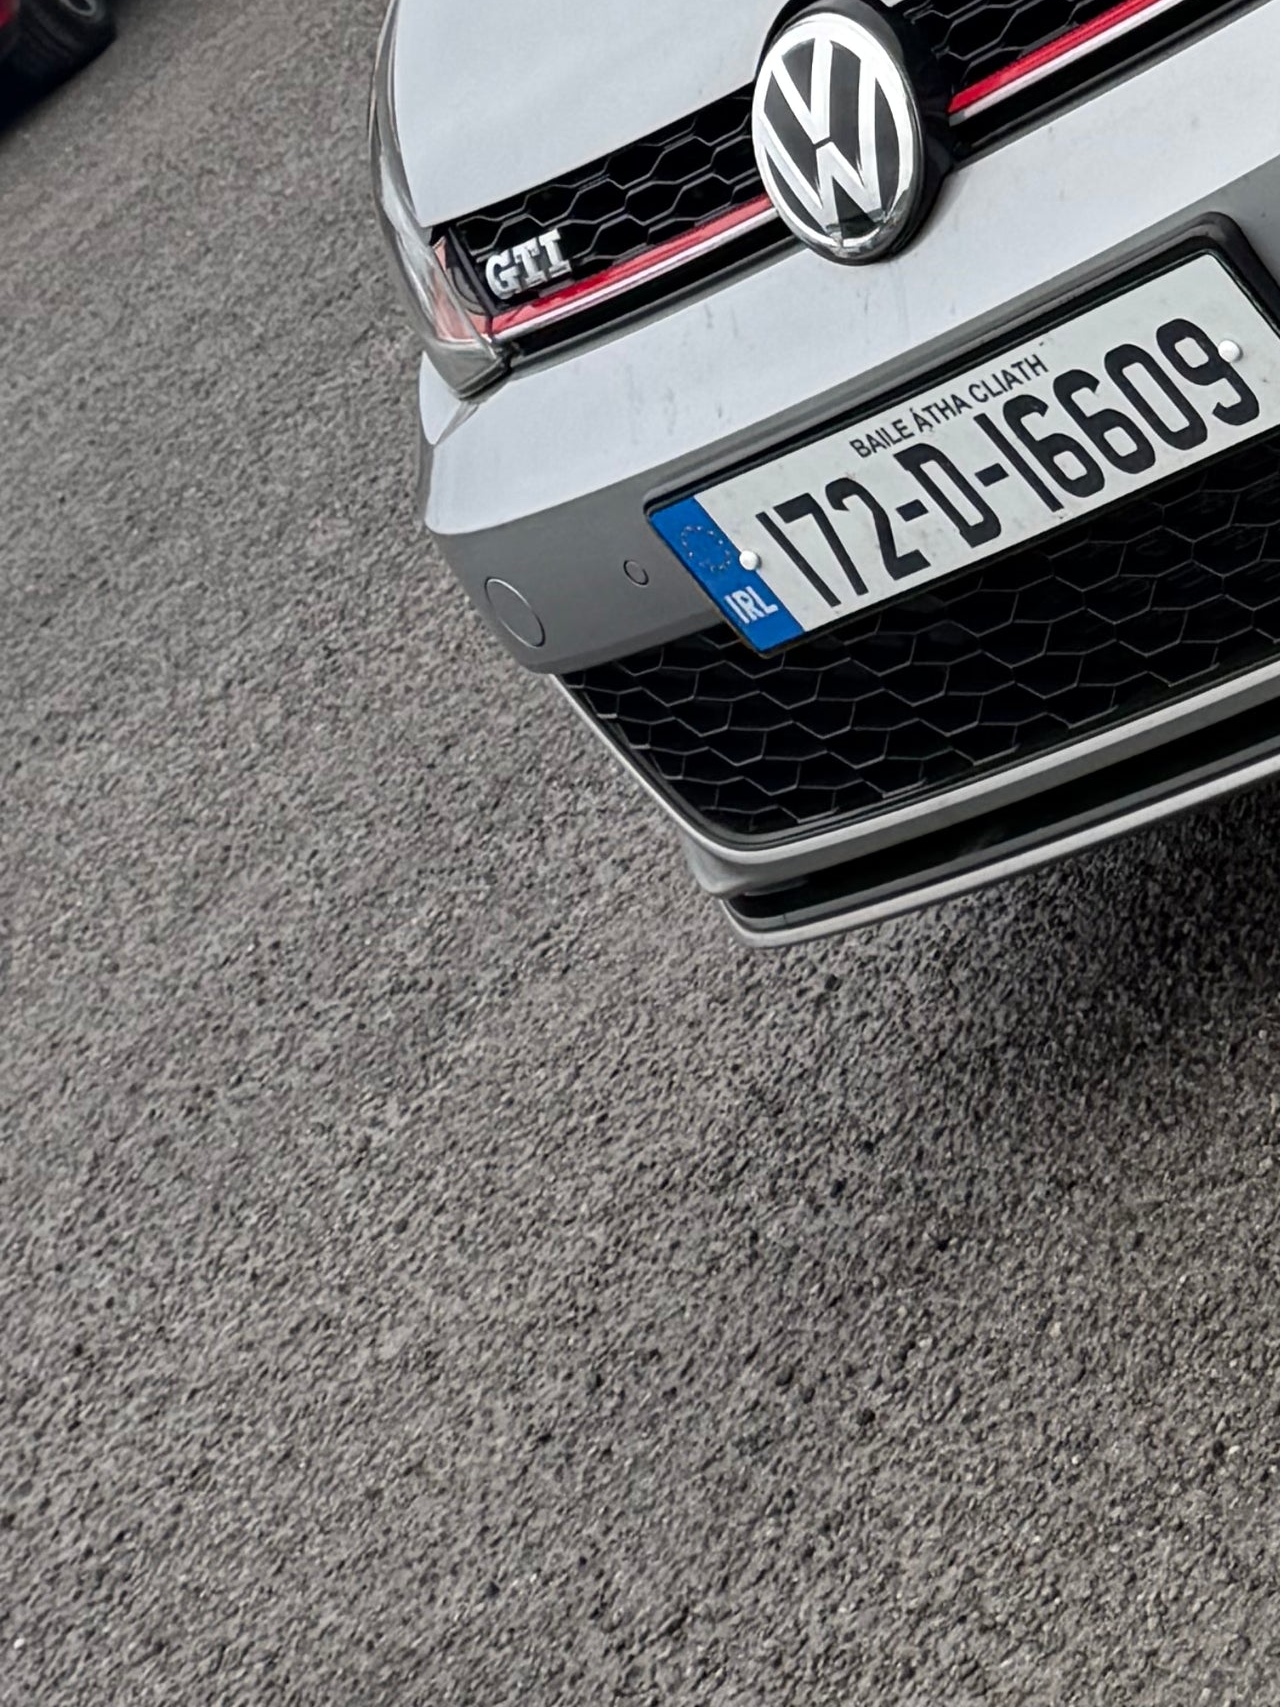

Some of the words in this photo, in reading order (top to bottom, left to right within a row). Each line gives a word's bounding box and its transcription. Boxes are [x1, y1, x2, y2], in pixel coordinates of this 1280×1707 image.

[485, 228, 572, 300] GTI
[849, 419, 915, 458] BAILE
[909, 393, 973, 434] ÁTHA
[968, 354, 1050, 404] CLIATH
[755, 316, 1261, 608] 172-D-16609
[724, 585, 779, 624] IRL
